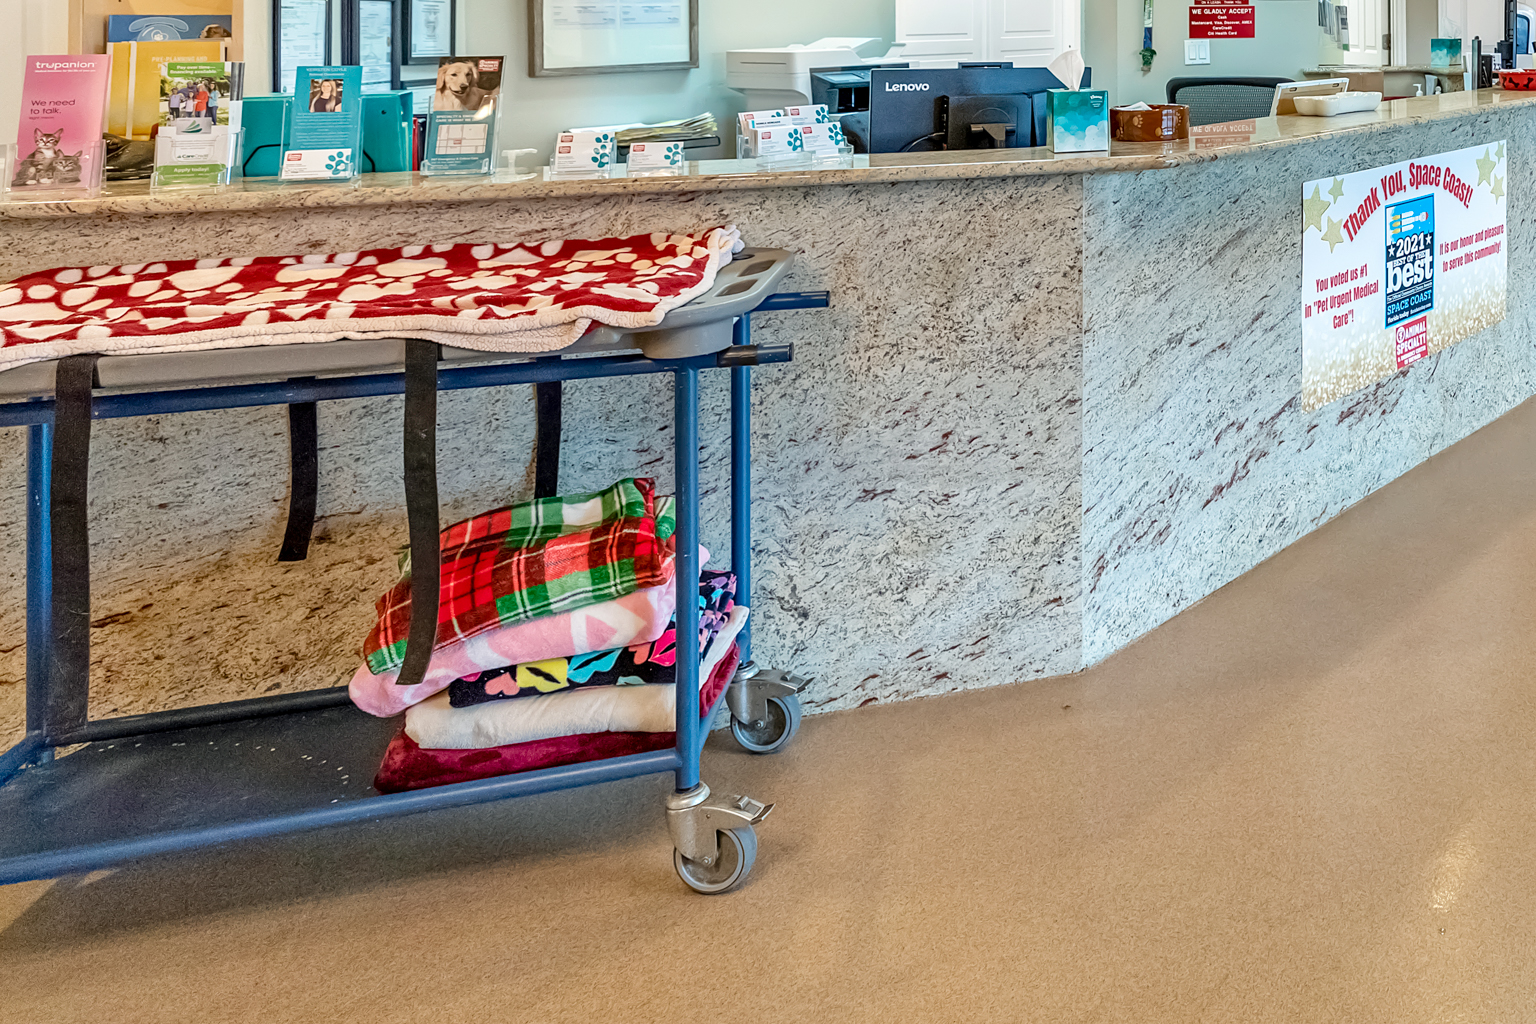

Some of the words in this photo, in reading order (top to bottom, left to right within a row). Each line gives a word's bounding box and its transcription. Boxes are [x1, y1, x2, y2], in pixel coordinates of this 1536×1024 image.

[36, 61, 95, 70] trupanion
[885, 82, 930, 91] Lenovo
[1343, 186, 1381, 242] Thank
[1380, 170, 1406, 200] You,
[1409, 162, 1441, 190] Space
[1443, 167, 1474, 209] Coast!
[1396, 232, 1424, 258] 2021
[1440, 243, 1443, 255] It
[1444, 241, 1449, 254] is
[1450, 239, 1459, 252] our
[1460, 234, 1474, 248] honor
[1475, 229, 1483, 243] and
[1484, 224, 1504, 241] pleasure
[1393, 256, 1406, 267] BEST
[1407, 254, 1414, 263] OF
[1415, 251, 1426, 260] THE
[1443, 261, 1448, 272] to
[1449, 256, 1463, 270] serve
[1464, 251, 1473, 264] this
[1475, 240, 1501, 261] community!
[1316, 278, 1328, 293] You
[1330, 269, 1348, 288] voted
[1350, 268, 1358, 281] us
[1360, 263, 1367, 278] #1
[1387, 248, 1433, 294] best
[1305, 304, 1312, 319] in
[1314, 297, 1328, 314] "Pet
[1330, 289, 1352, 309] Urgent
[1354, 279, 1378, 301] Medical
[1387, 298, 1409, 315] SPACE
[1410, 289, 1432, 306] COAST
[1333, 309, 1354, 329] Care"!
[1405, 321, 1426, 339] ANIMAL
[1397, 332, 1426, 355] SPECIALTY
